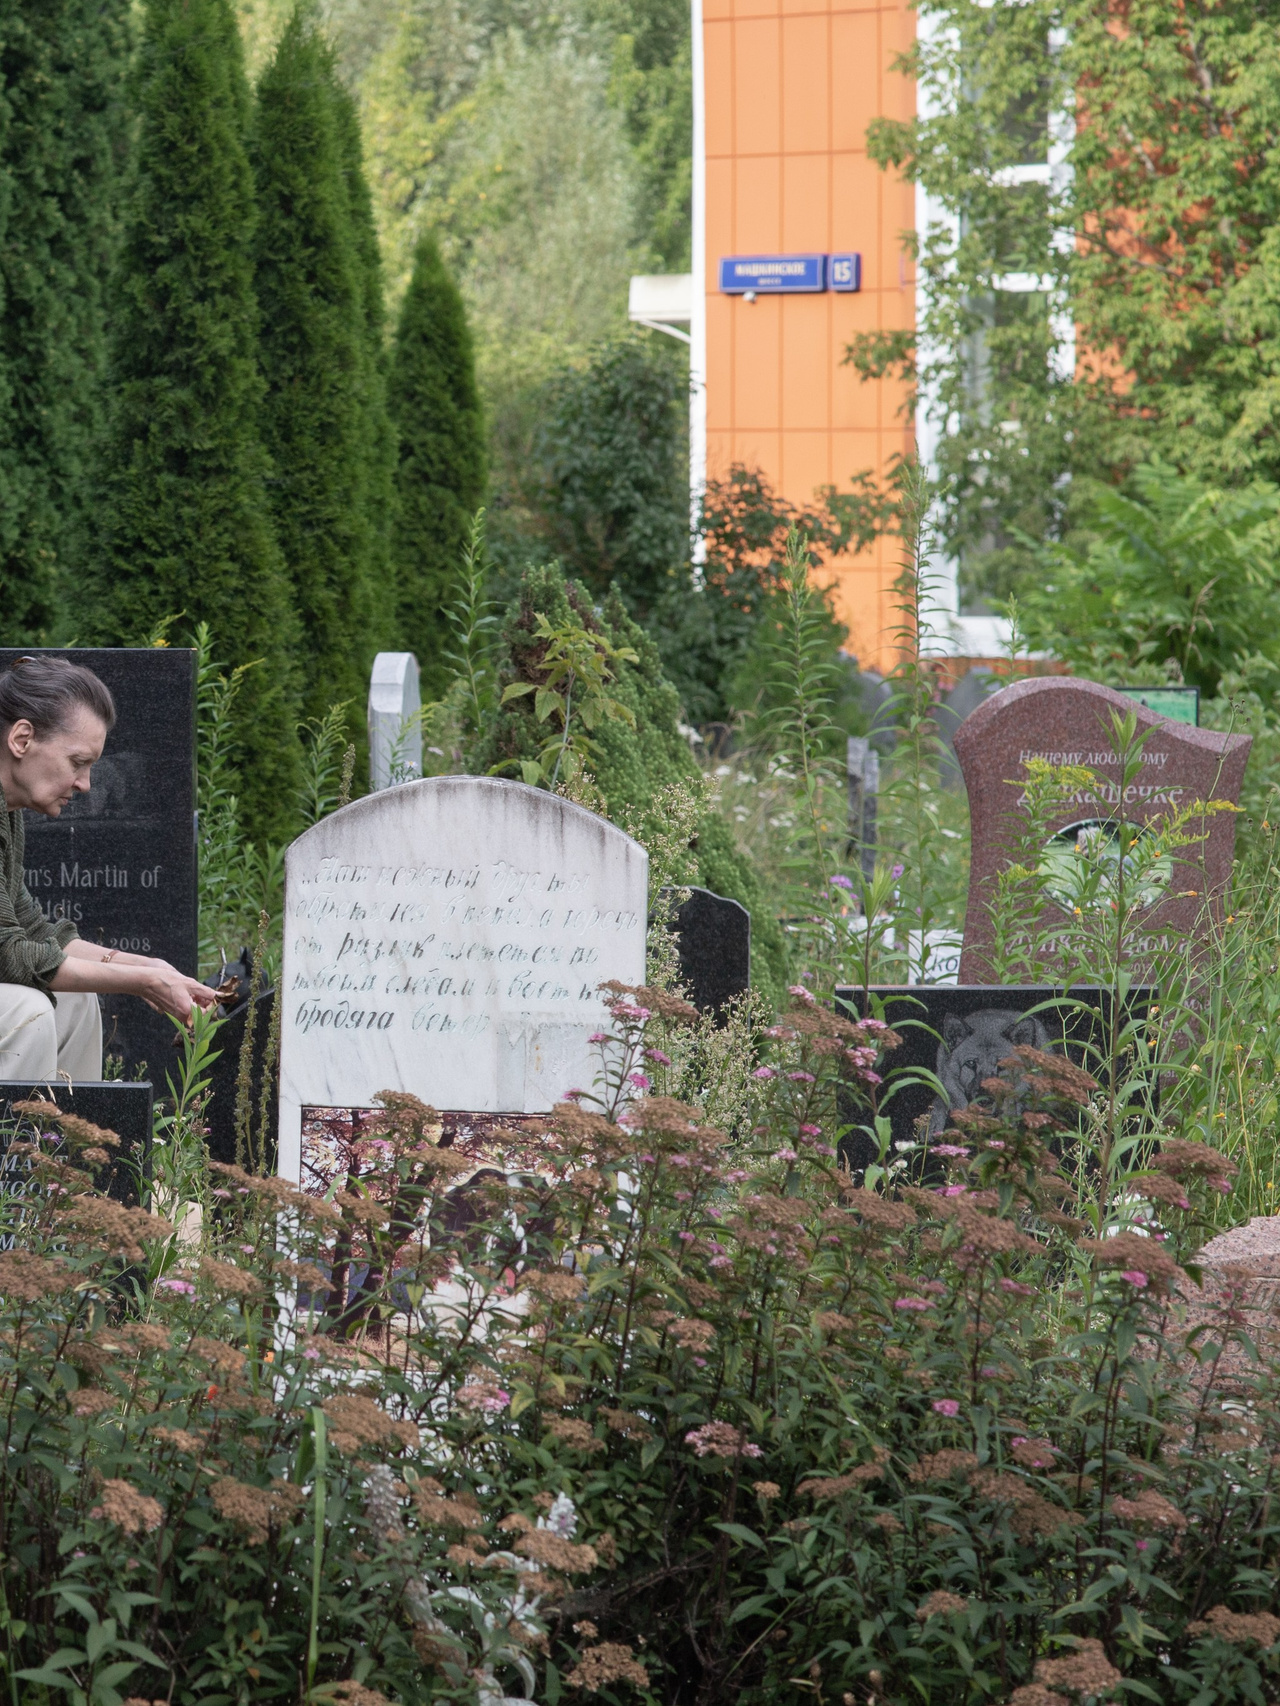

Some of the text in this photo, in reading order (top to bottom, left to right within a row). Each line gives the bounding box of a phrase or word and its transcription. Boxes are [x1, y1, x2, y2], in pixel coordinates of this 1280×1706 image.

[835, 262, 851, 282] 15
[60, 861, 128, 888] Martin
[140, 865, 163, 888] of
[294, 998, 396, 1034] бродяга
